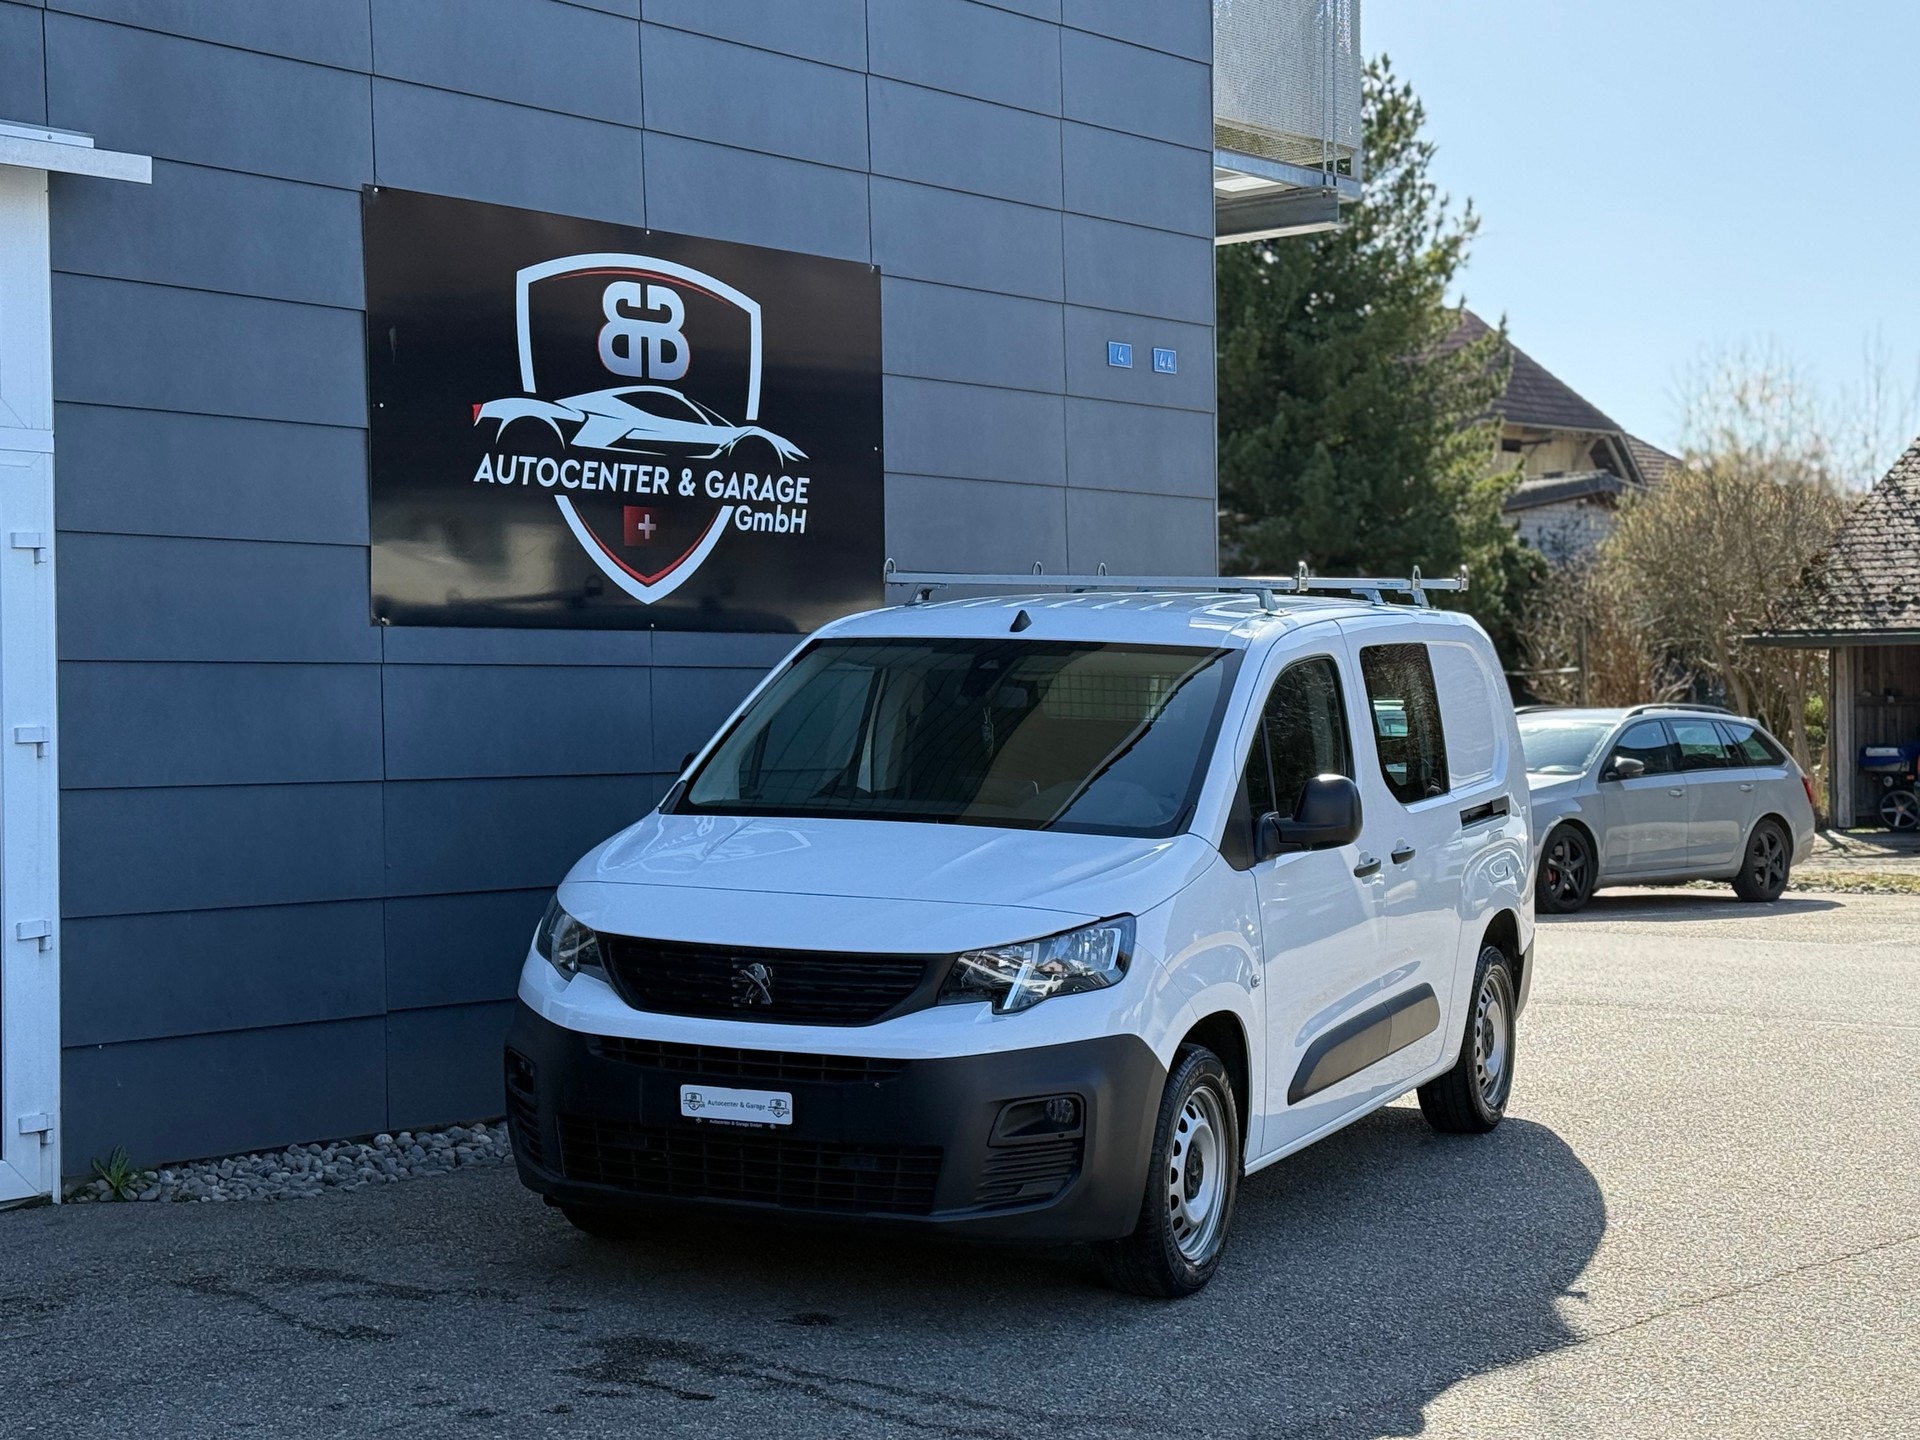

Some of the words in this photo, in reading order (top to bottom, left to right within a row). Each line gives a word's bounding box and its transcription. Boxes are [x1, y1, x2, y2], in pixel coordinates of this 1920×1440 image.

[1117, 346, 1125, 363] 4
[473, 452, 669, 495] AUTOCENTER
[678, 468, 696, 497] &
[704, 470, 811, 504] GARAGE
[734, 504, 807, 534] GmbH
[707, 1099, 739, 1108] Autocenter
[746, 1102, 766, 1111] Garage
